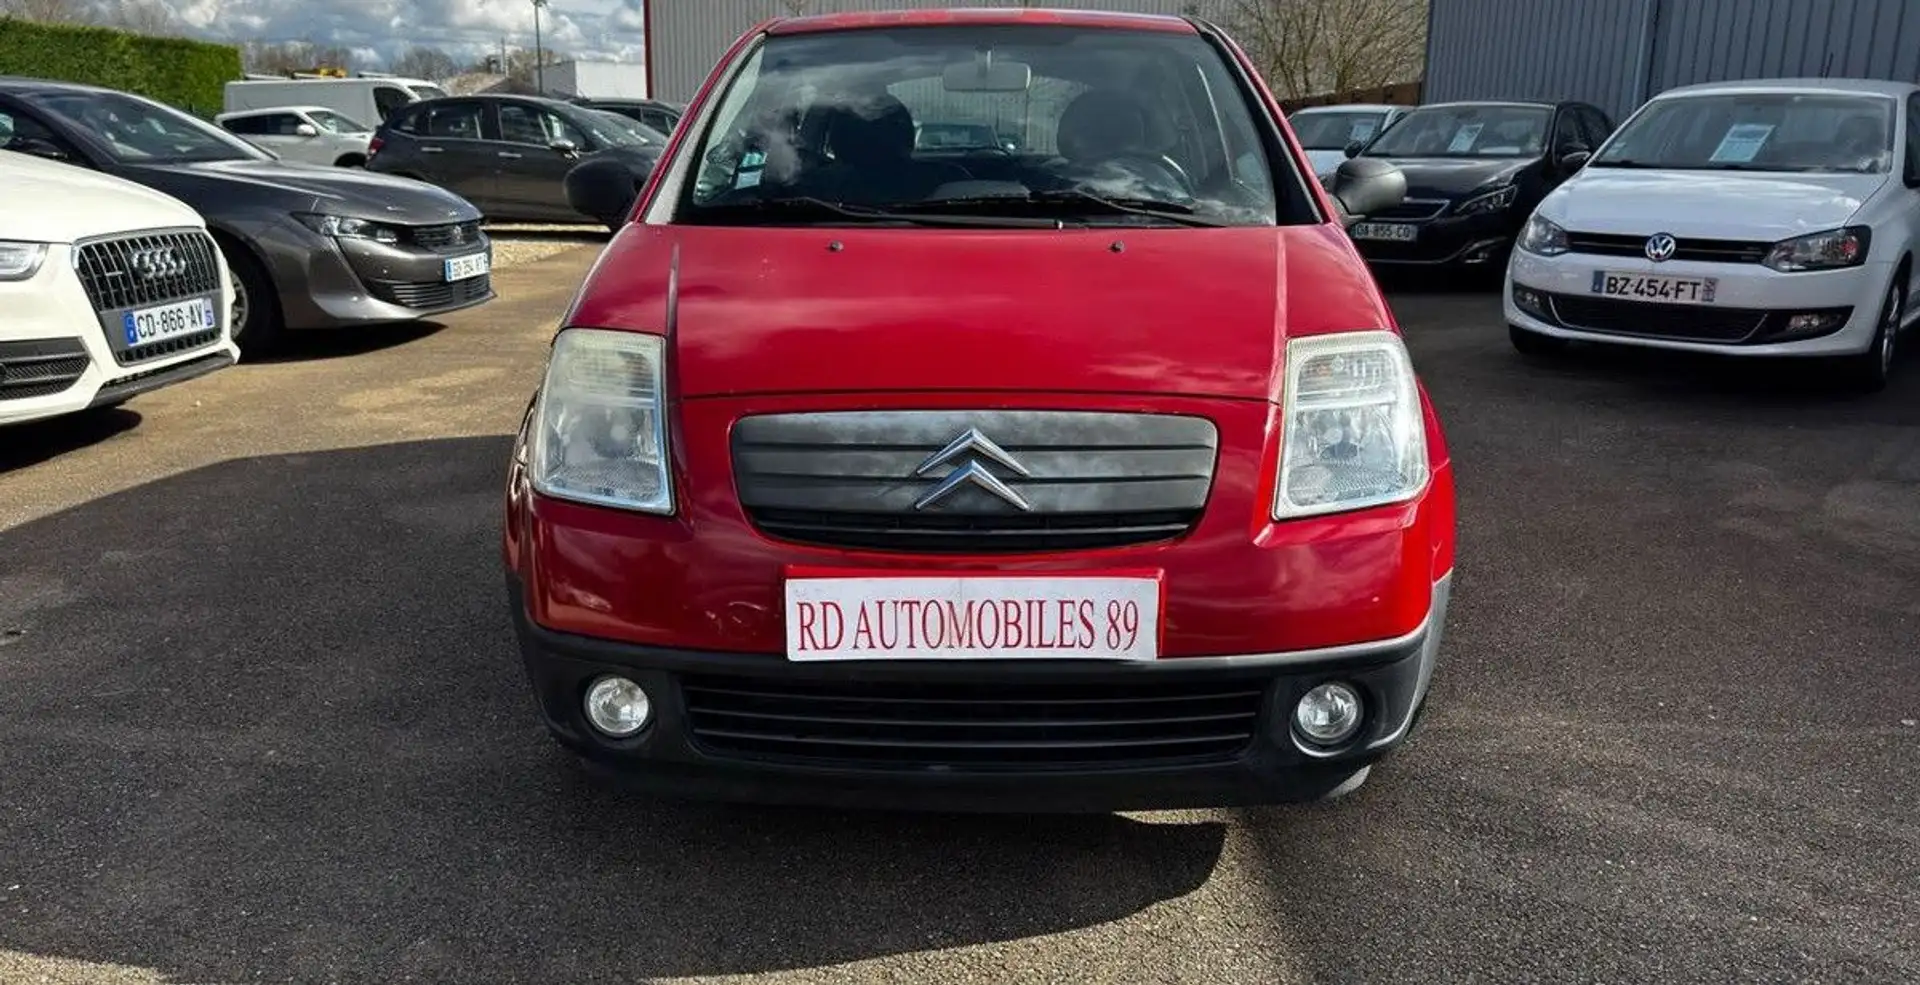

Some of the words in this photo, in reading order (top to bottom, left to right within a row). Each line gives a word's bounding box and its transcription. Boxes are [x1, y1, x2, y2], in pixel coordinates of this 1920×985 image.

[1605, 276, 1701, 300] BZ-454-FT
[136, 303, 203, 338] CD-866-AV
[797, 600, 844, 651] RD
[853, 599, 1096, 650] AUTOMOBILES
[1106, 599, 1139, 651] 89
